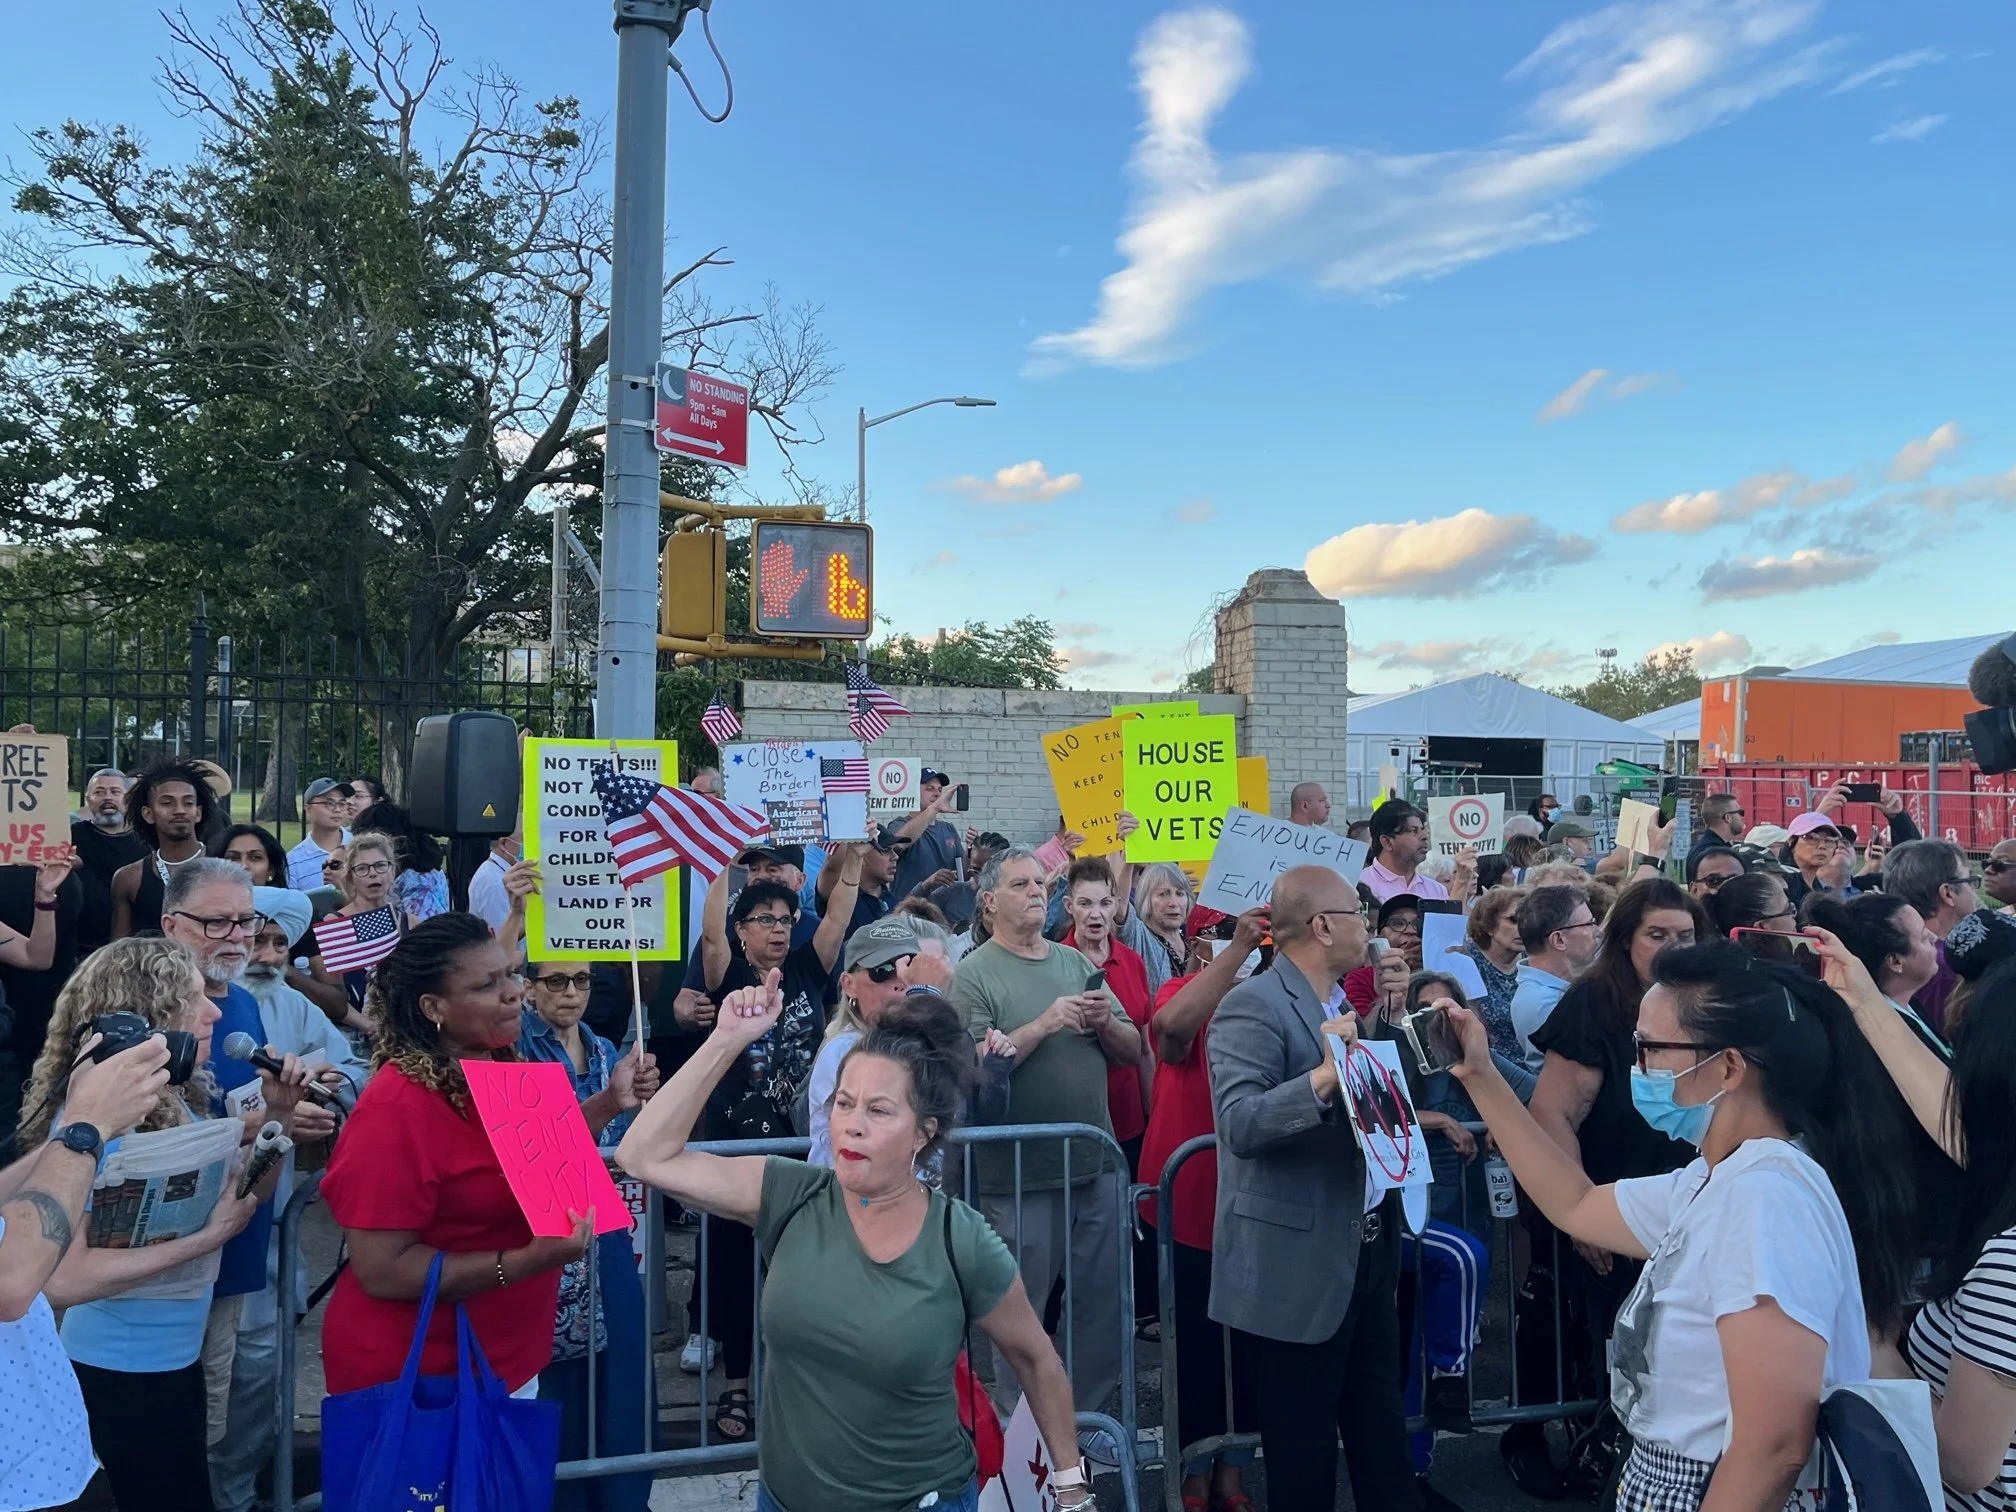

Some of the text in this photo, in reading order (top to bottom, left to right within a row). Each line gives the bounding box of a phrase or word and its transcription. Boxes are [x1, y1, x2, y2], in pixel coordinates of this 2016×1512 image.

[690, 378, 745, 405] NO STANDING
[690, 398, 705, 413] 9pm
[711, 405, 727, 418] 5am
[690, 412, 717, 430] All Days
[1745, 734, 1756, 744] 53
[1051, 731, 1121, 762] NO TEN
[1138, 740, 1224, 765] HOUSE
[0, 743, 50, 777] REE
[747, 746, 804, 768] Close
[1100, 749, 1124, 763] CIT
[544, 757, 570, 771] NO
[764, 767, 794, 779] The
[886, 772, 901, 784] NO
[1974, 775, 1991, 785] BIC
[544, 781, 583, 794] NOT
[759, 774, 816, 794] Border!
[1073, 773, 1105, 790] KEEP
[1155, 779, 1213, 803] OUR
[869, 796, 915, 809] ENT CITY!
[772, 808, 819, 818] American
[1081, 811, 1122, 829] CHILD
[1460, 812, 1481, 826] NO
[780, 818, 812, 827] Dream
[1146, 816, 1224, 841] VETS
[9, 823, 46, 846] US
[559, 830, 597, 843] FOR
[778, 828, 788, 836] is
[789, 827, 806, 836] Not
[1230, 814, 1354, 863] ENOUGH
[1599, 838, 1617, 851] 15
[548, 851, 617, 866] CHILDR
[1269, 855, 1288, 873] is
[562, 874, 600, 887] USE
[558, 897, 608, 909] LAND
[585, 918, 625, 930] OUR
[485, 1070, 541, 1114] NO
[491, 1104, 577, 1164] TENT
[1491, 1171, 1508, 1184] bai
